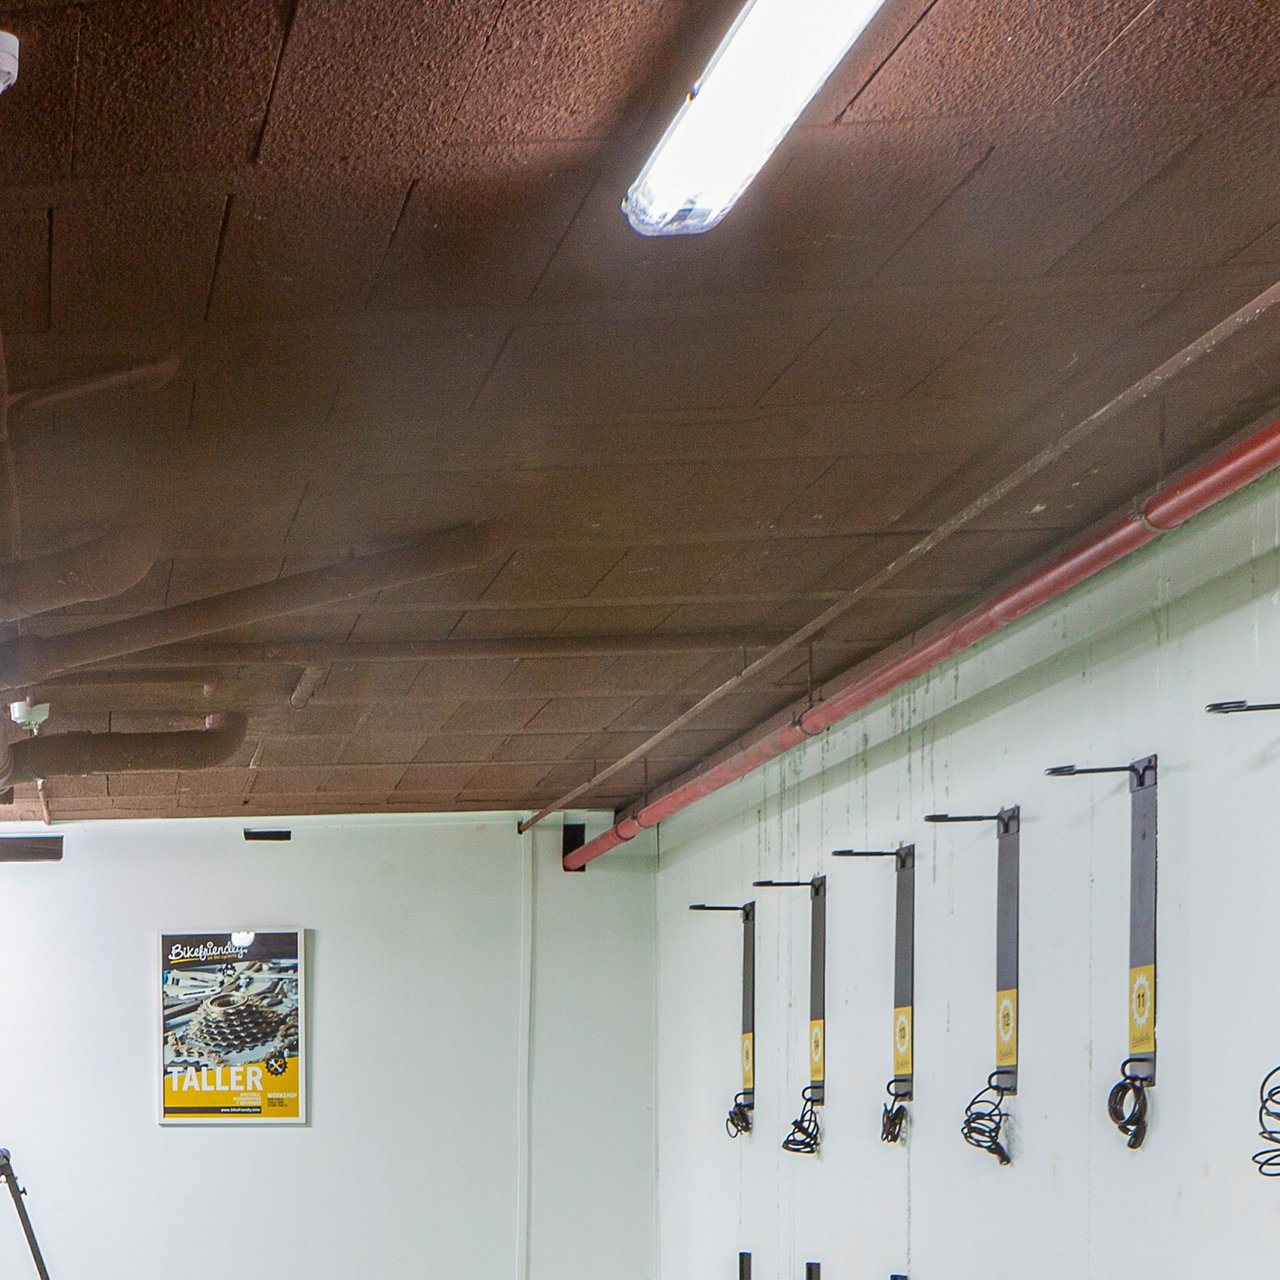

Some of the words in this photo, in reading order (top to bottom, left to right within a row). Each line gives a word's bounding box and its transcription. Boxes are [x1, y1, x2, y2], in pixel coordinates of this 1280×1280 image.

[1137, 992, 1145, 1008] 11
[1003, 1012, 1010, 1027] 12
[167, 1066, 263, 1091] TALLER
